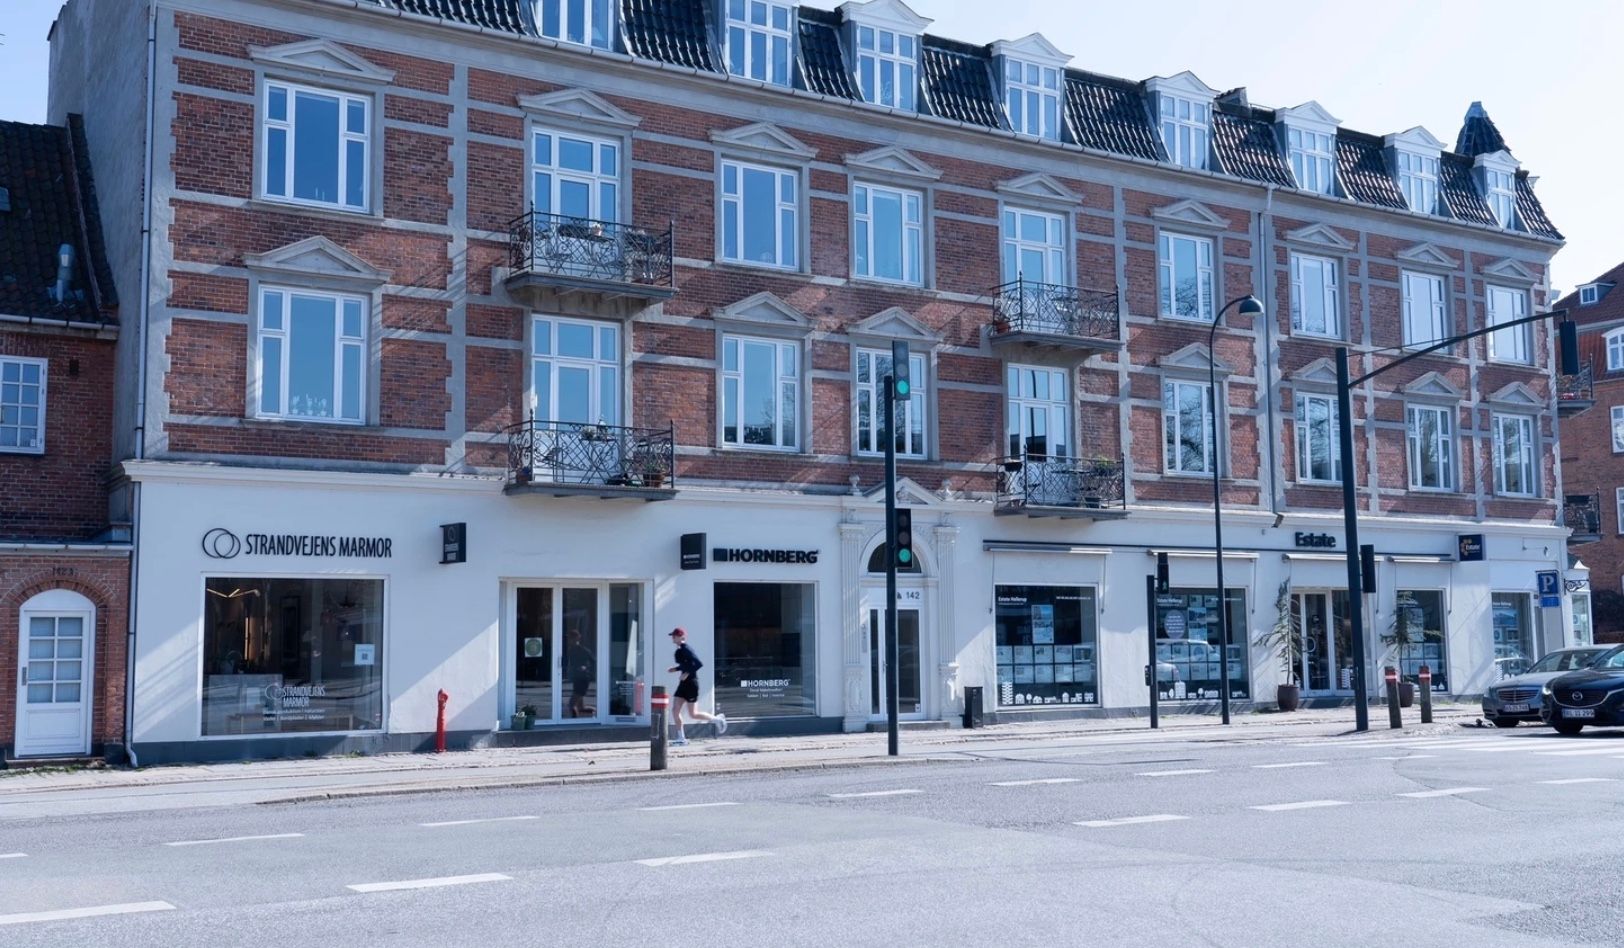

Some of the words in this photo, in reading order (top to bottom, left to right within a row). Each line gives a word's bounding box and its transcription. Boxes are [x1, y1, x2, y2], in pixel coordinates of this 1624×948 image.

[245, 534, 336, 556] STRANDVEJENS
[338, 537, 392, 558] MARMOR
[1295, 531, 1336, 548] Estate
[729, 548, 818, 564] HORNBERG
[1541, 574, 1555, 592] P
[906, 591, 921, 600] 142
[747, 679, 790, 687] HORNBERG
